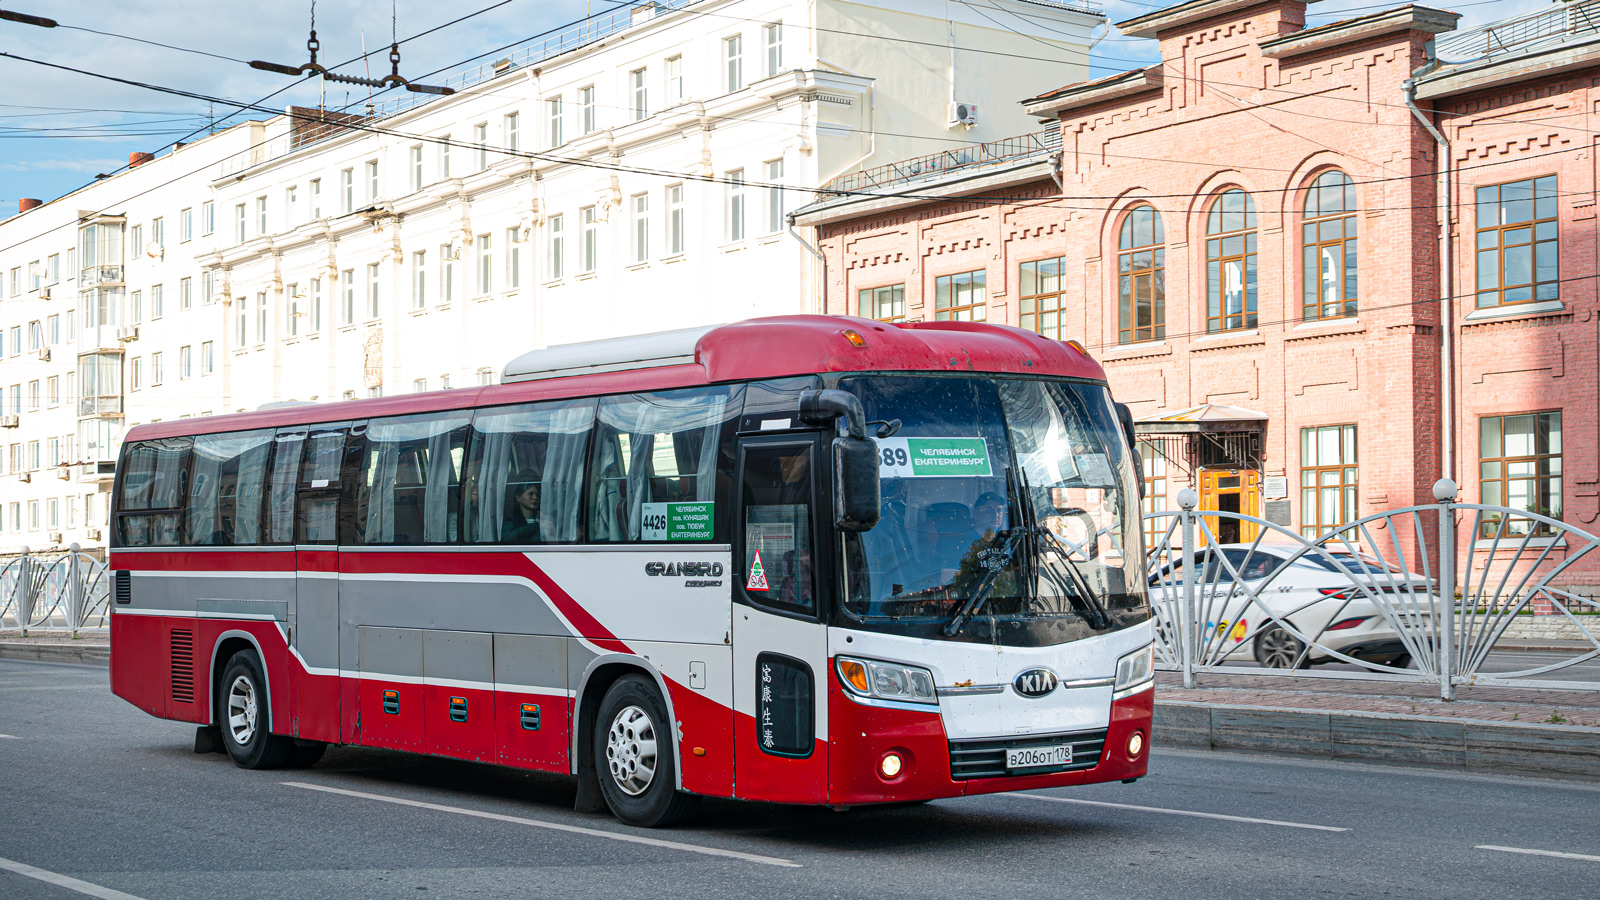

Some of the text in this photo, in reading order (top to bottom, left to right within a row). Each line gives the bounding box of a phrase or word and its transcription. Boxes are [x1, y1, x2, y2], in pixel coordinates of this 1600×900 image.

[920, 448, 976, 456] ЧЕЛЯБИНСК
[914, 457, 985, 466] ЕКАТЕРИНБУРГ
[675, 505, 707, 513] ЧЕЛЯБИНСК
[643, 514, 666, 530] 4426
[686, 522, 706, 530] ТЮБУК
[671, 531, 711, 539] ЕКАТЕРИНБУРГ
[645, 561, 724, 577] GRANBIRD
[1021, 674, 1053, 693] KIA
[1054, 747, 1071, 759] 178
